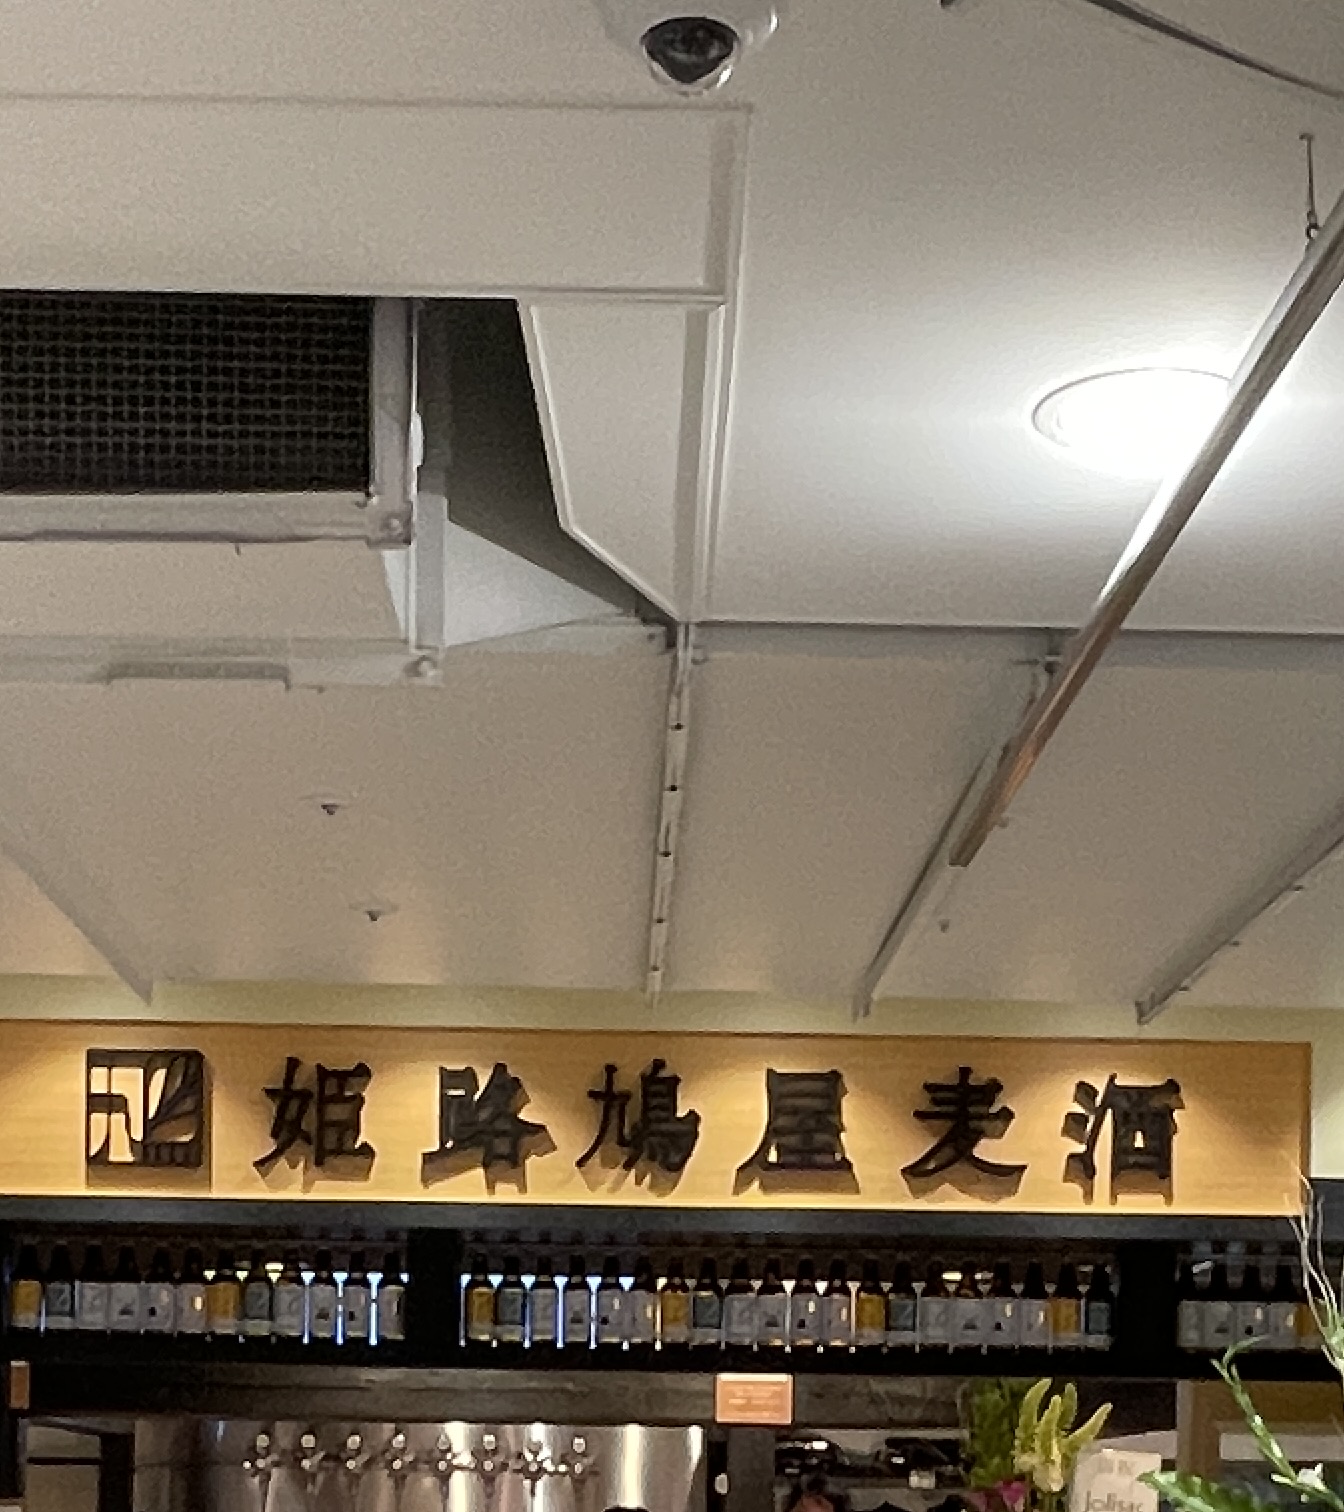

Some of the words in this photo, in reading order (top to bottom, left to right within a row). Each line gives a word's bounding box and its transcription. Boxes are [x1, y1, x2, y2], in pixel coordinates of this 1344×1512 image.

[256, 1056, 1182, 1182] 姫路鳩屋麦酒
